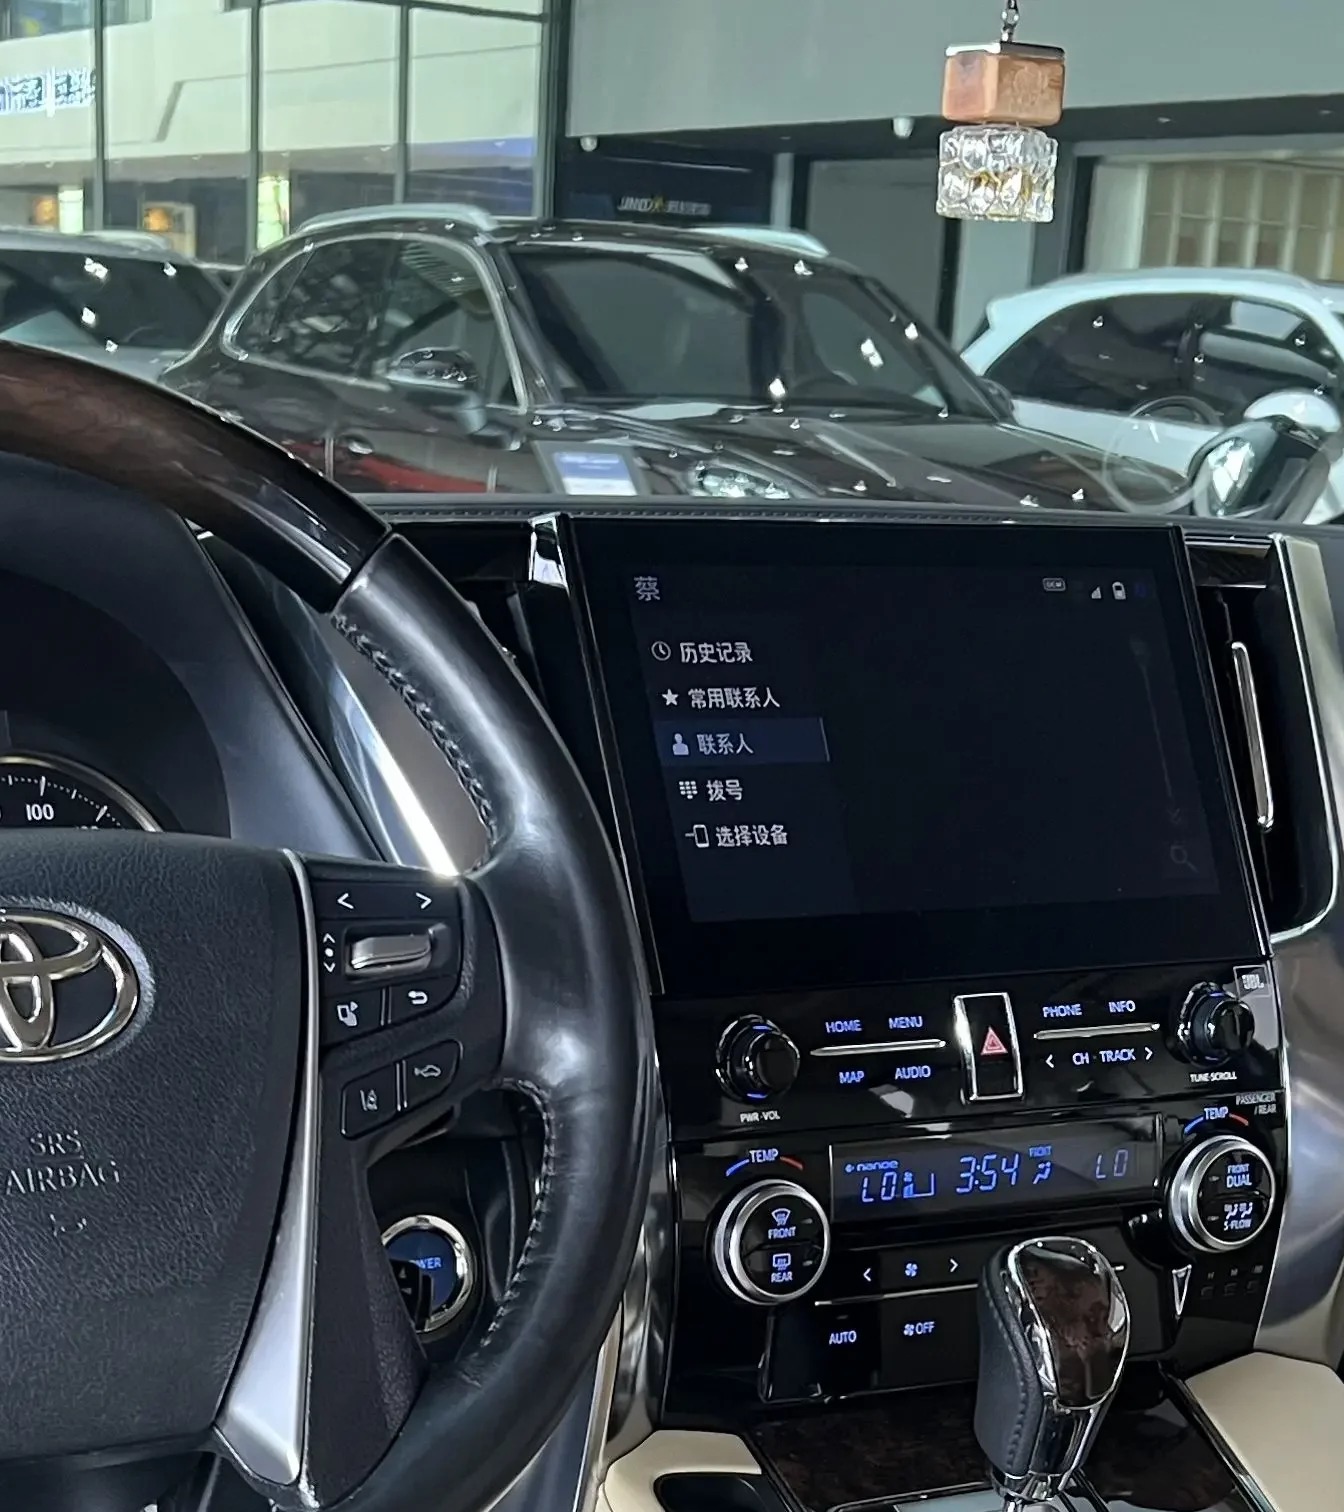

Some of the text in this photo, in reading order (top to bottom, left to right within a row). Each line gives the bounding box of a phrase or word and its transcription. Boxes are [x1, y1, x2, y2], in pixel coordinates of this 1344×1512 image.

[679, 642, 753, 663] 历史记录
[688, 687, 780, 709] 常用联系人
[697, 733, 754, 755] 联系人
[706, 780, 743, 801] 拨号
[26, 803, 54, 820] 100
[715, 825, 788, 847] 选择设备
[1043, 1004, 1082, 1018] PHONE
[1108, 1000, 1136, 1013] INFO
[825, 1020, 862, 1033] HOME
[888, 1016, 923, 1029] MENU
[1100, 1049, 1136, 1062] TRACK
[839, 1071, 865, 1084] MAP
[895, 1065, 931, 1080] AUDIO
[1236, 1092, 1276, 1105] PASSENGER
[1204, 1106, 1229, 1120] TEMP
[30, 1130, 83, 1157] SRS
[749, 1149, 779, 1162] TEMP
[6, 1161, 120, 1195] AIRBAG
[956, 1153, 1020, 1193] 3:54
[1227, 1174, 1252, 1188] DUAL
[768, 1226, 796, 1239] FRONT
[771, 1272, 793, 1283] REAR
[915, 1321, 935, 1335] OFF
[829, 1330, 857, 1344] AUTO
